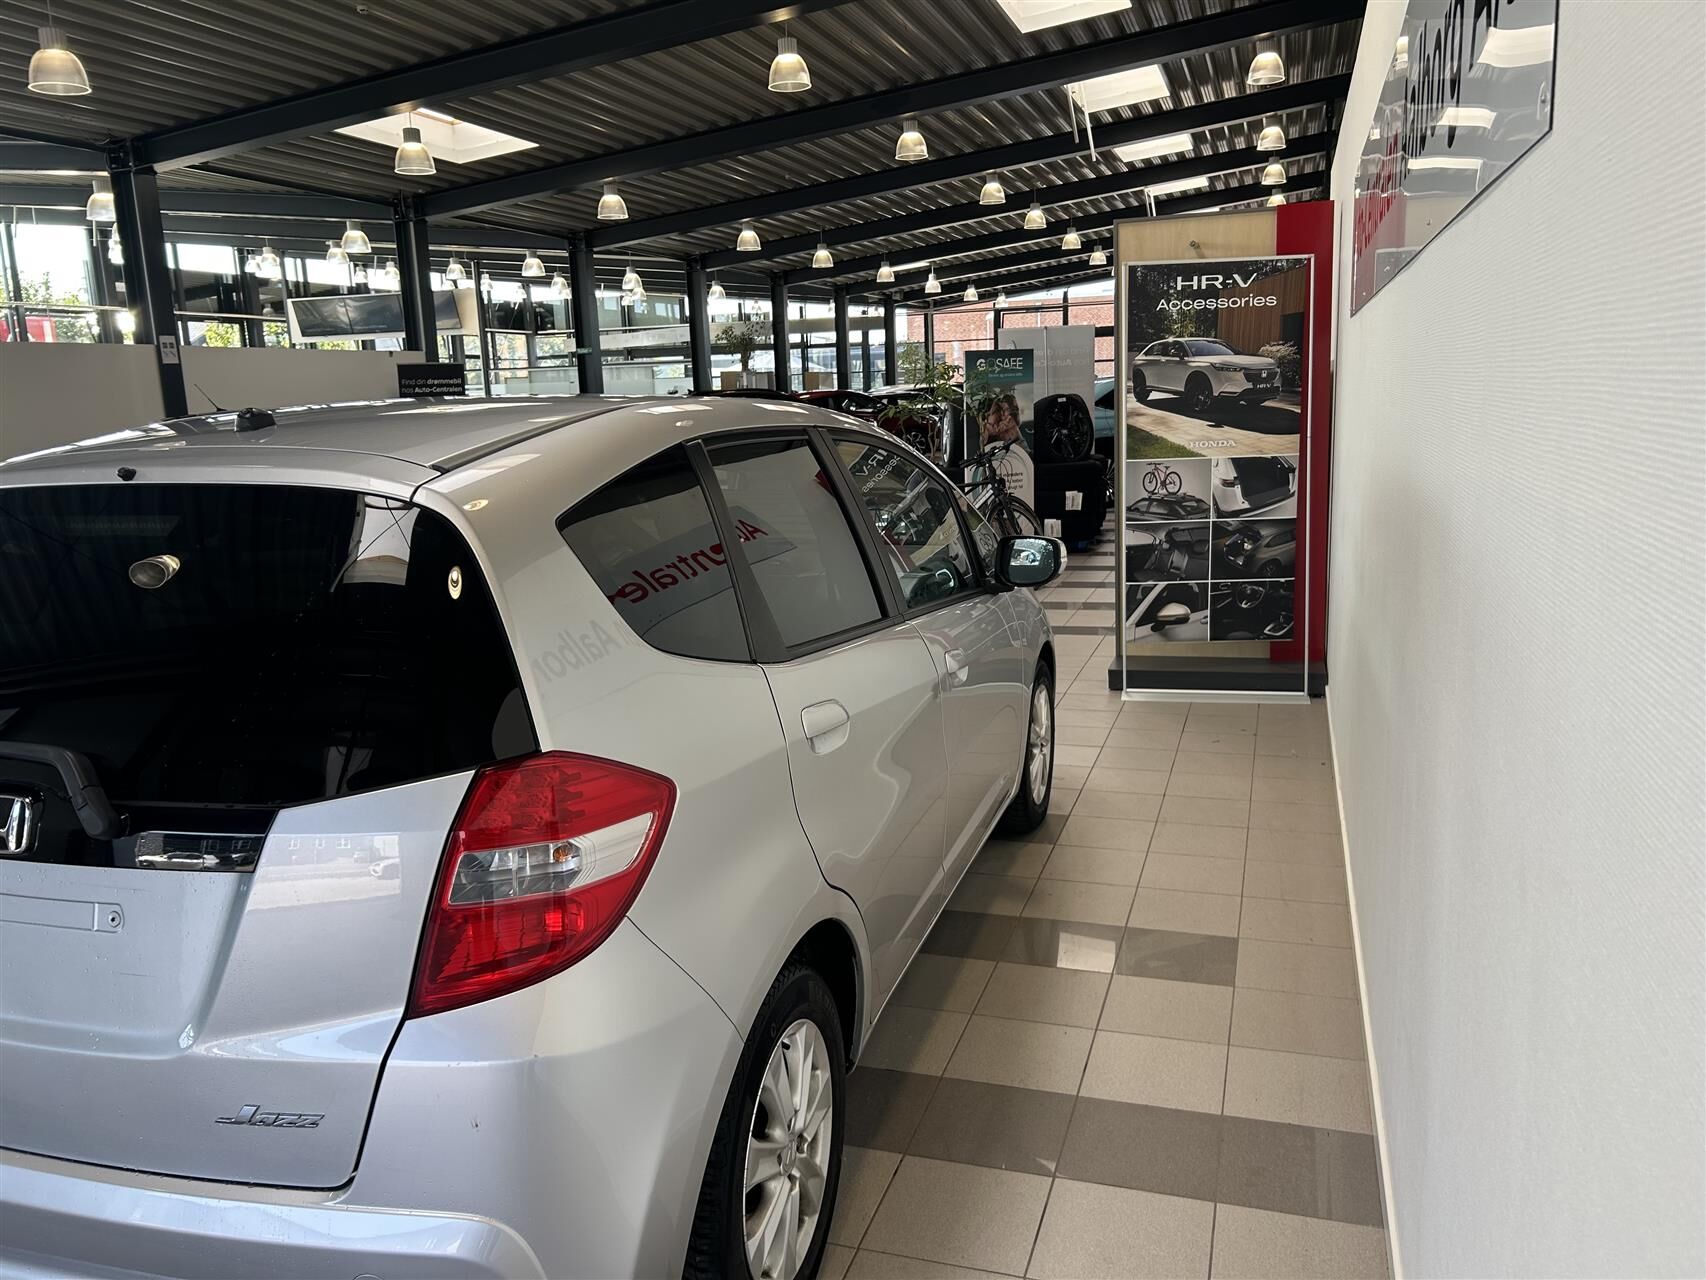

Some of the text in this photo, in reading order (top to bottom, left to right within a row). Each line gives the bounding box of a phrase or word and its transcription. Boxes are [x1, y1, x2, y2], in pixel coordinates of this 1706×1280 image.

[1176, 273, 1257, 290] HR-V
[1156, 294, 1277, 311] Accessories
[414, 385, 463, 393] Auto-Centralen
[1190, 439, 1237, 448] HONDA
[214, 1104, 326, 1128] Jazz
